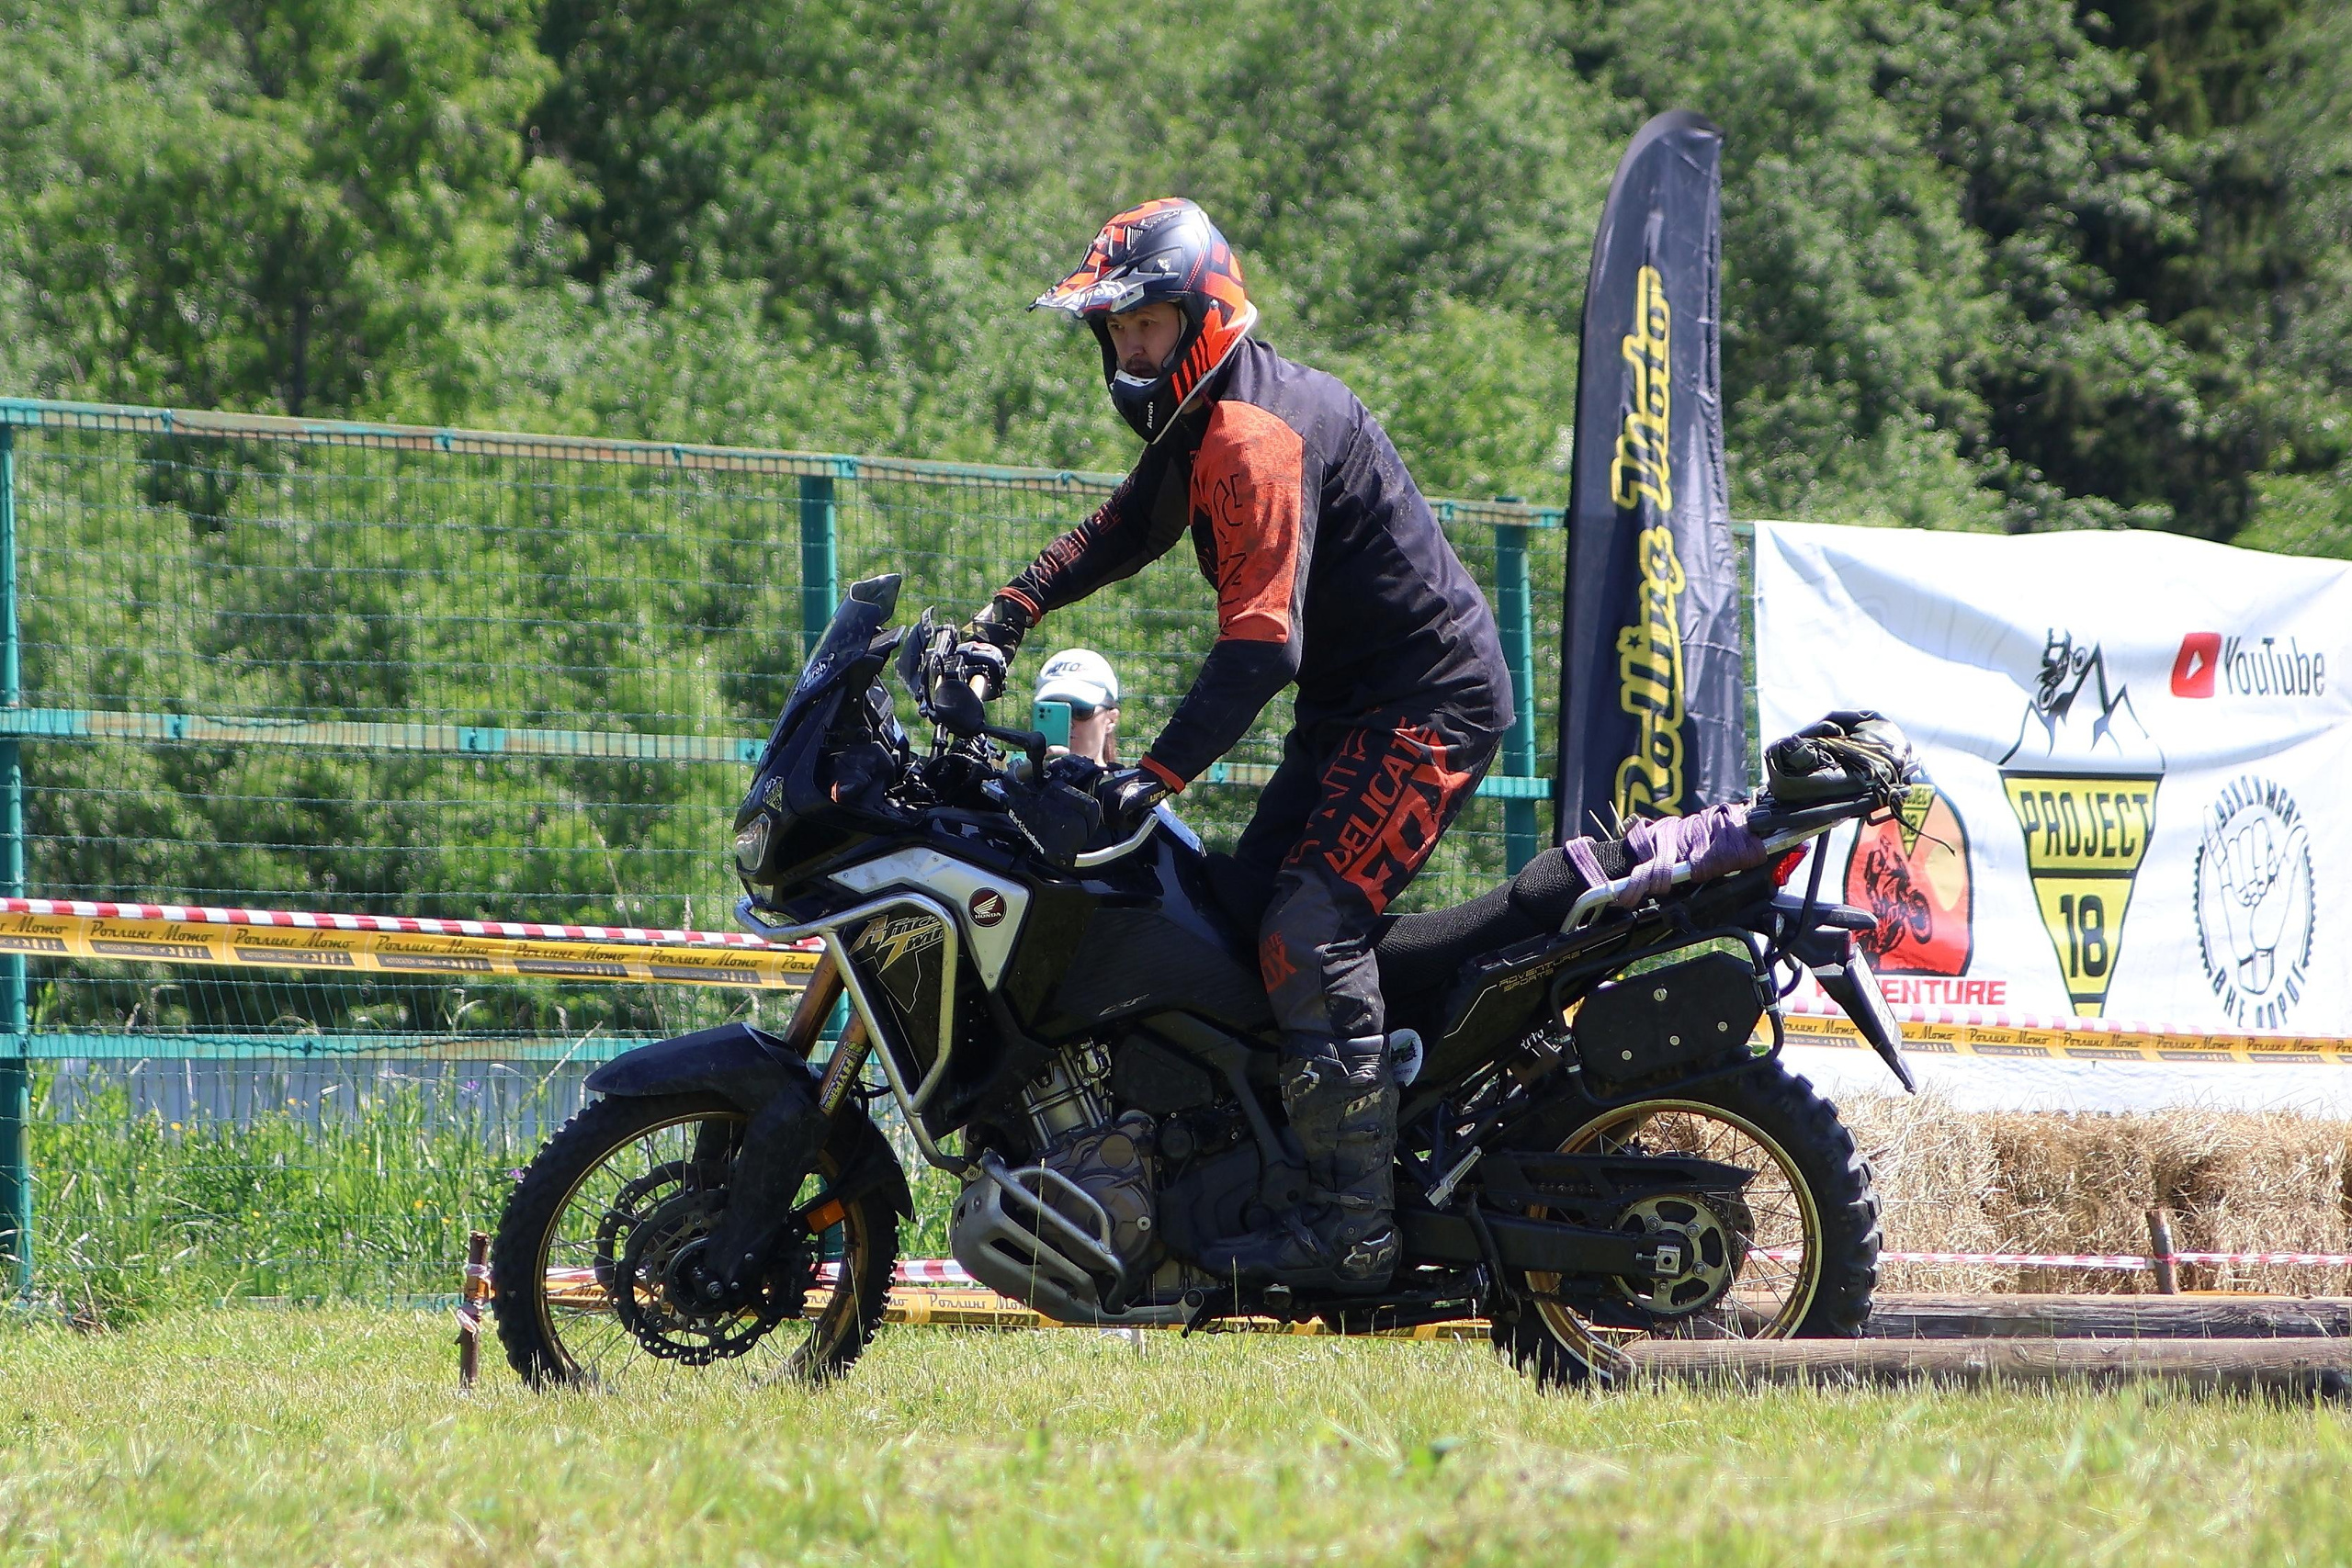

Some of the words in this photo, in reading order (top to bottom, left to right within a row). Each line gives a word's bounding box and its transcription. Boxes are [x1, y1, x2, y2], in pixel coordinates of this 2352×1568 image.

[1611, 265, 1674, 511] Moto
[1615, 525, 1687, 827] Rolling
[2223, 636, 2325, 697] YouTube
[2020, 791, 2149, 857] PROJECT
[2060, 894, 2109, 977] 18
[1498, 951, 1581, 987] ADVENTURE
[1503, 968, 1555, 992] SPORTS
